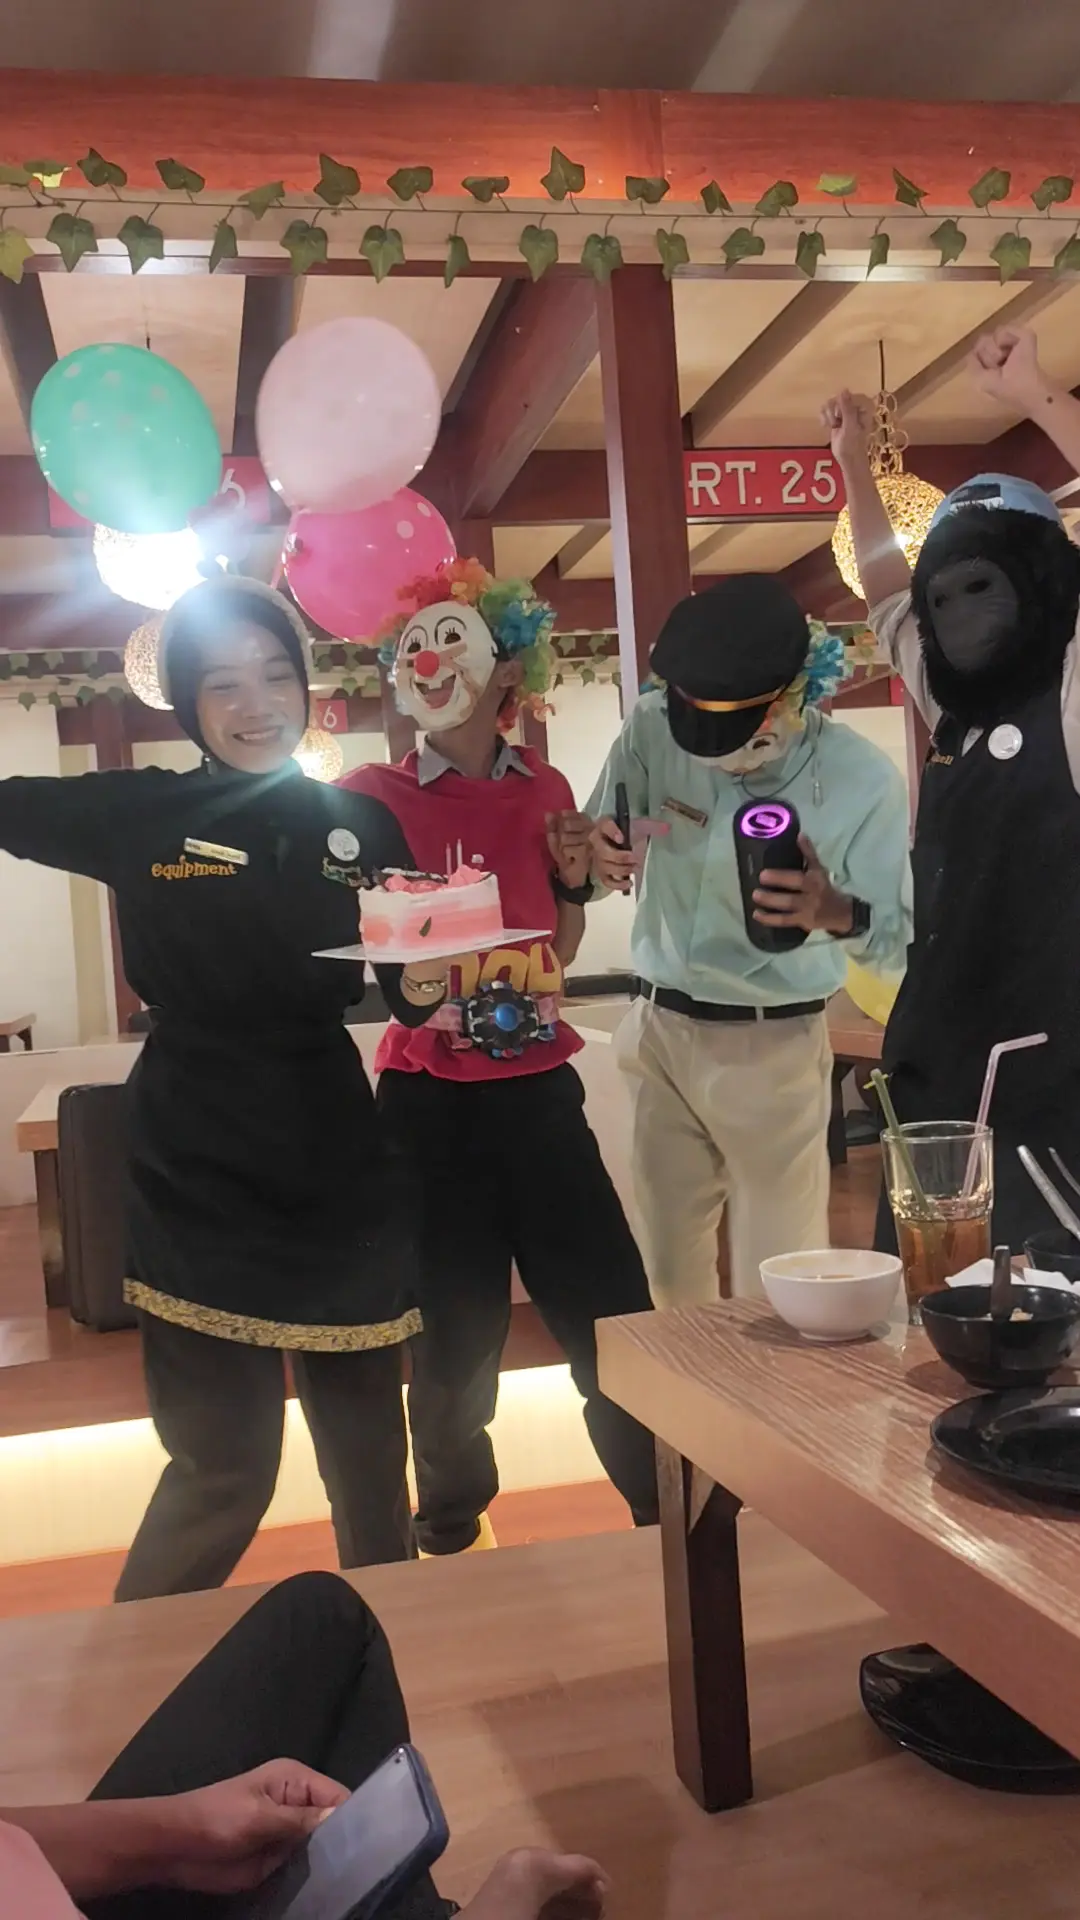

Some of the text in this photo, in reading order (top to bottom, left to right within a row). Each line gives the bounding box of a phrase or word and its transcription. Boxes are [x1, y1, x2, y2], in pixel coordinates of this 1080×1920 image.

[688, 459, 837, 507] RT. 25
[322, 705, 338, 729] 6
